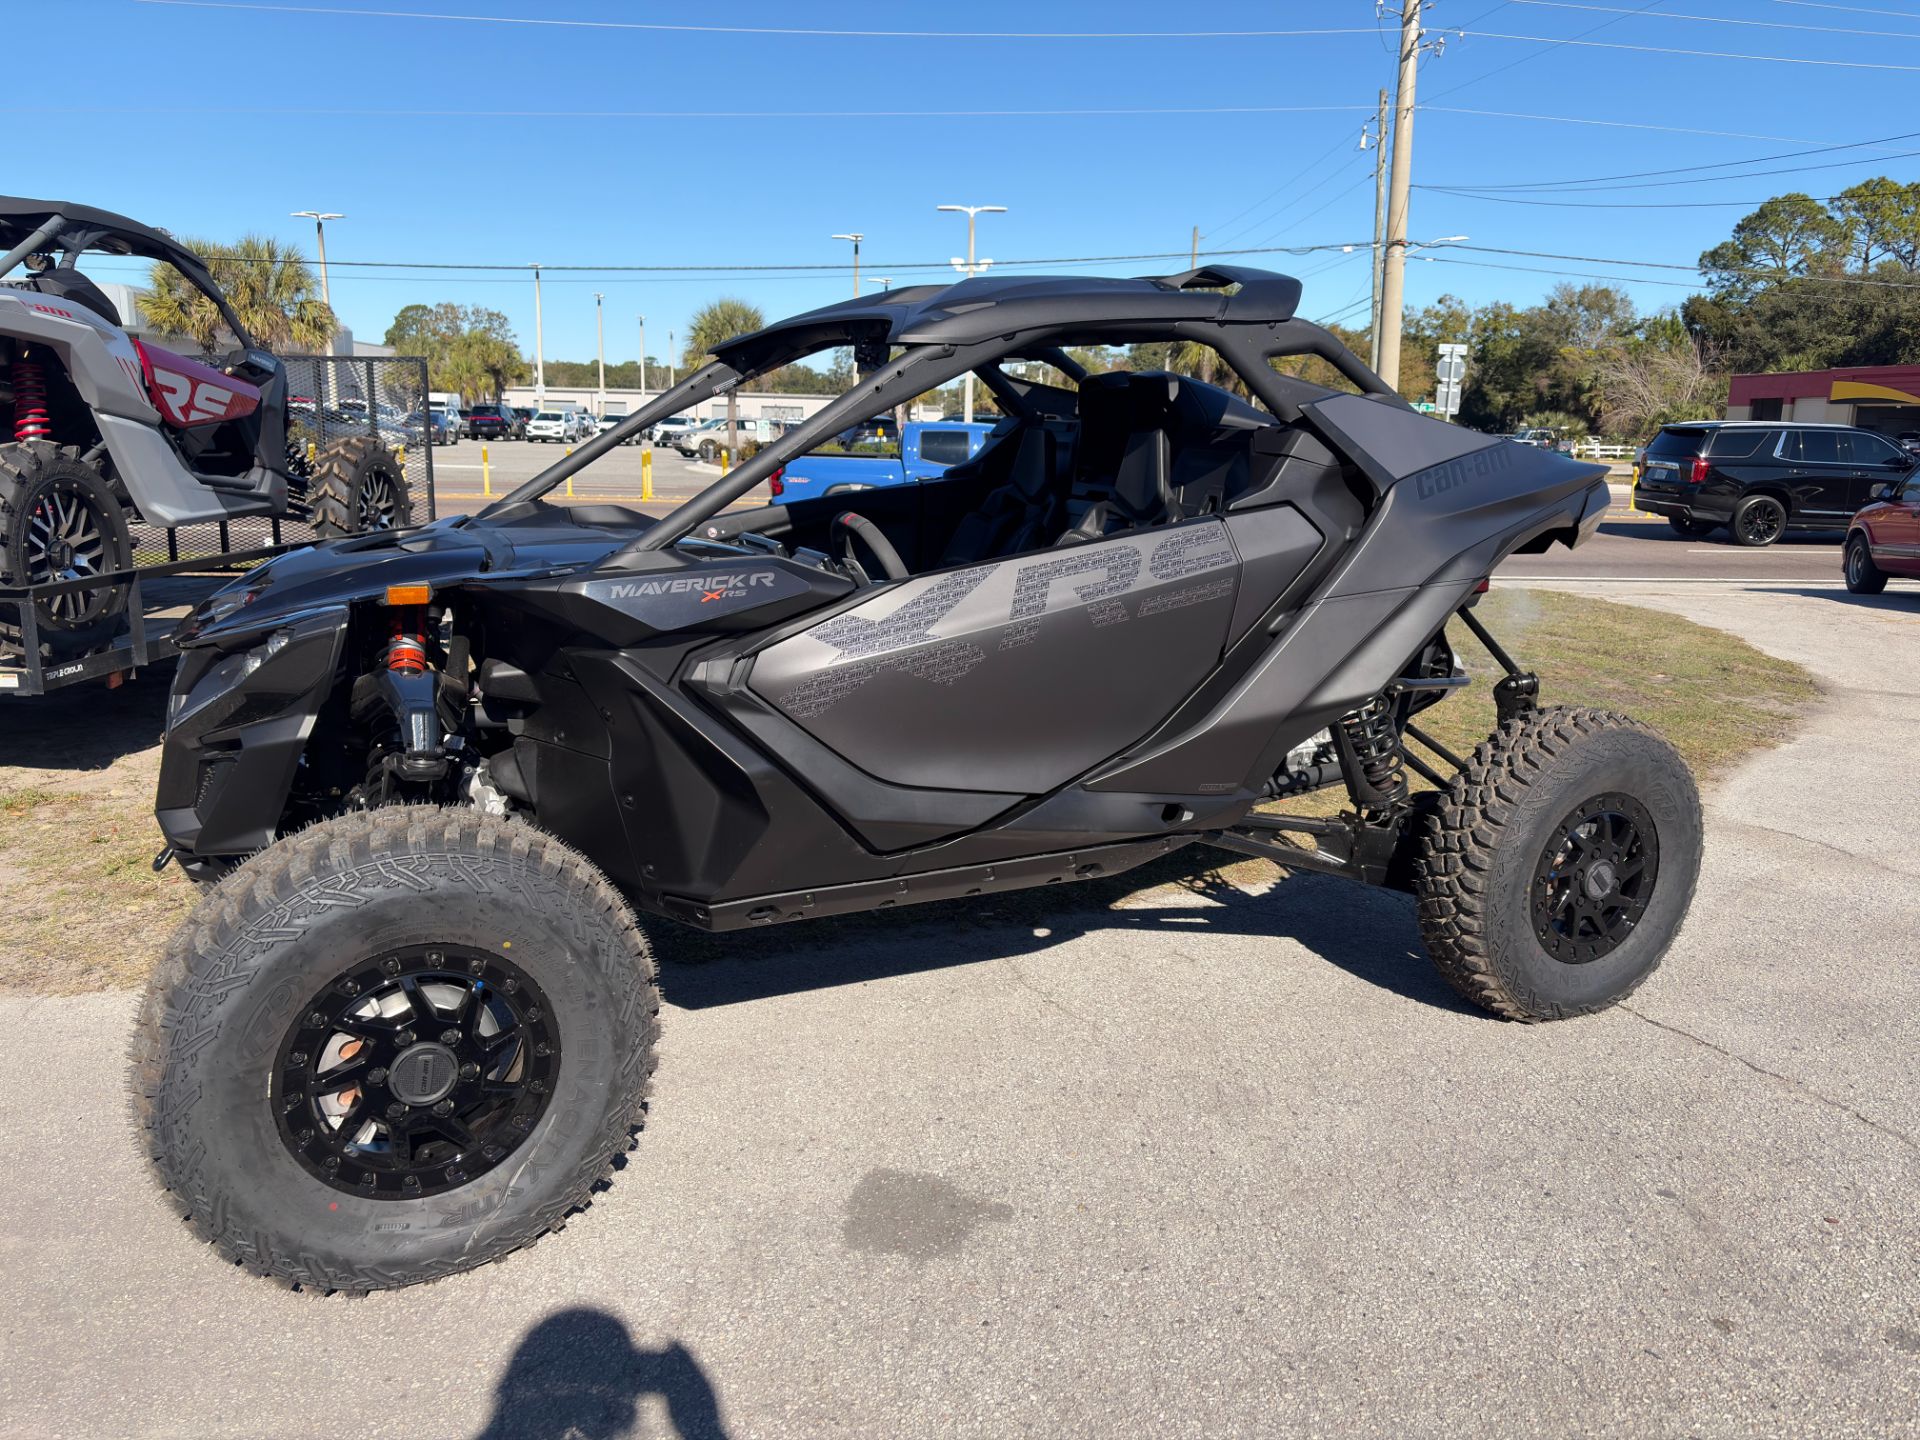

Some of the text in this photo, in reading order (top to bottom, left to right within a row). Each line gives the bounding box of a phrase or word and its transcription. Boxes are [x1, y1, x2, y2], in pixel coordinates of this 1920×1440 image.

[153, 366, 234, 422] RS
[1415, 446, 1512, 500] can-am
[610, 572, 776, 599] MAVERICK R
